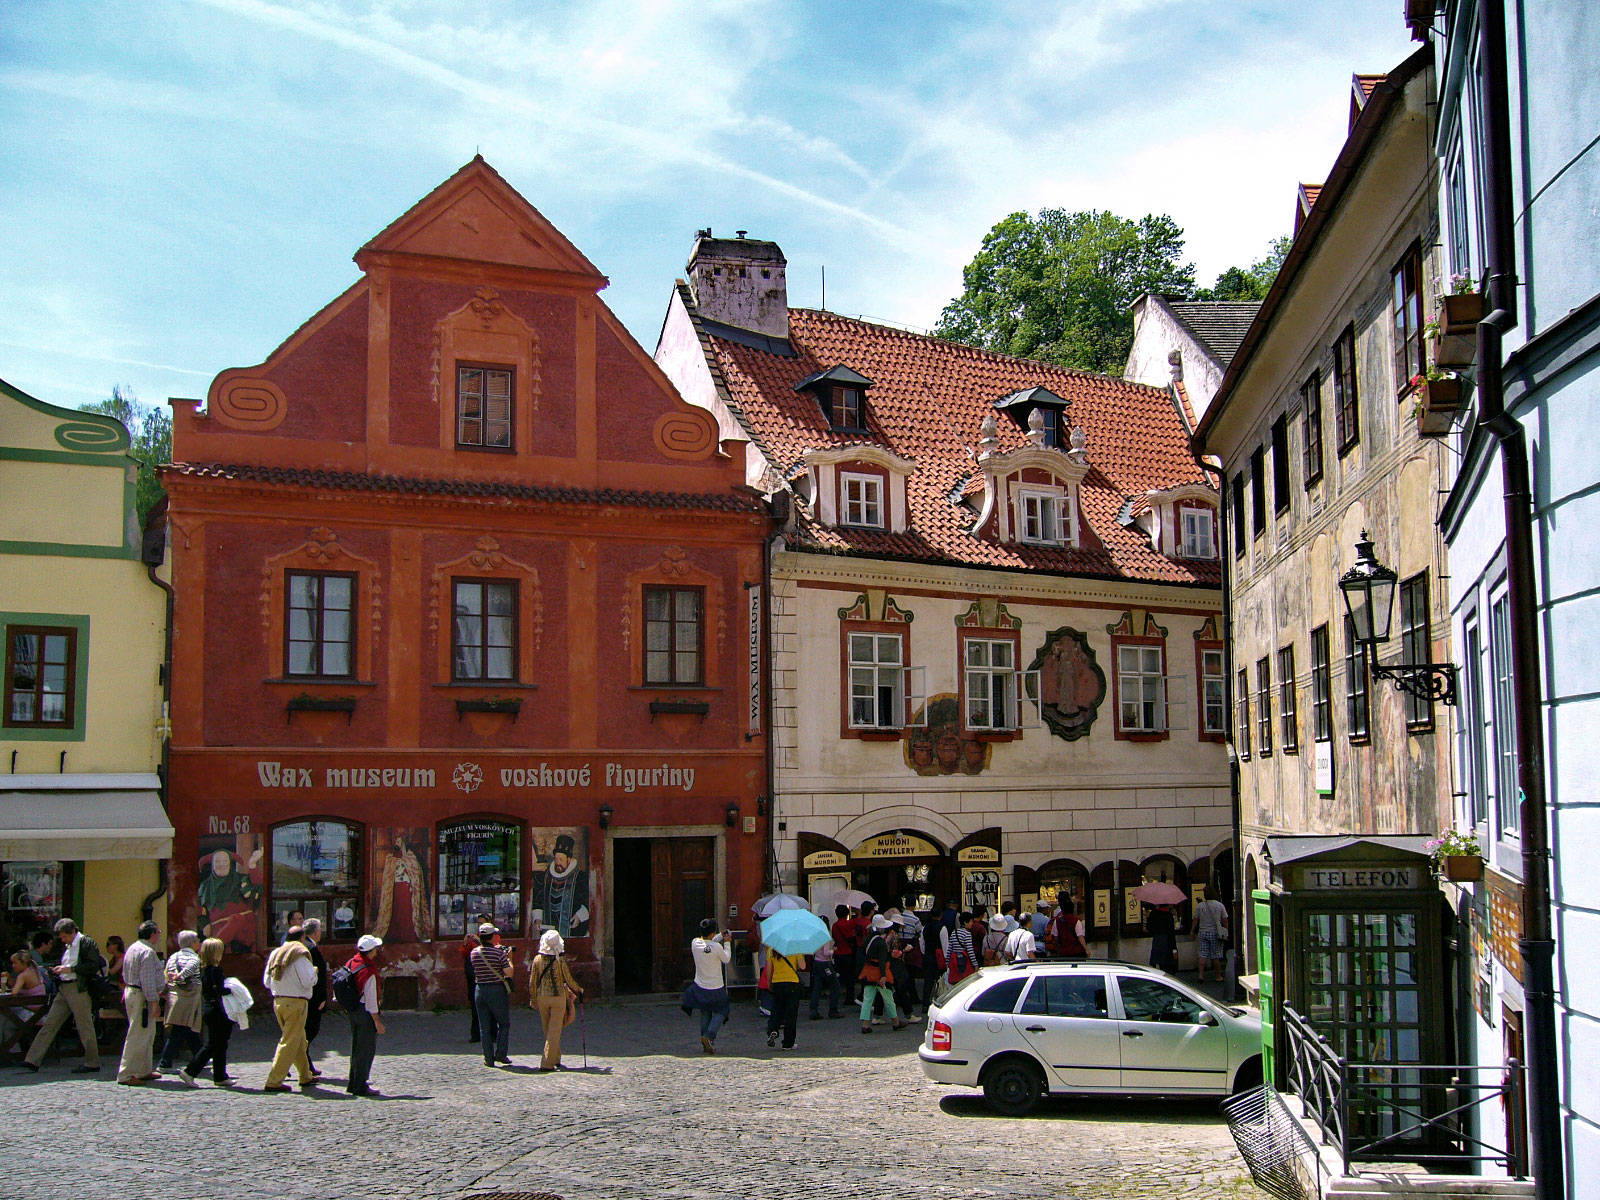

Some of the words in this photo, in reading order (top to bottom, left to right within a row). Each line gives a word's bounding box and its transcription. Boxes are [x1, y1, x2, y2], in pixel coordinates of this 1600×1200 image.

[751, 596, 759, 674] MUSEUM
[751, 680, 759, 720] WAX
[257, 761, 313, 788] Wax
[326, 767, 436, 788] museum
[500, 763, 591, 788] voskové
[605, 763, 695, 793] figuriny
[444, 824, 474, 835] MUZEUM
[877, 838, 910, 847] MUHONI
[872, 847, 915, 856] JEWELLERY
[814, 858, 837, 866] MUHONI
[1310, 871, 1409, 887] TELEFON
